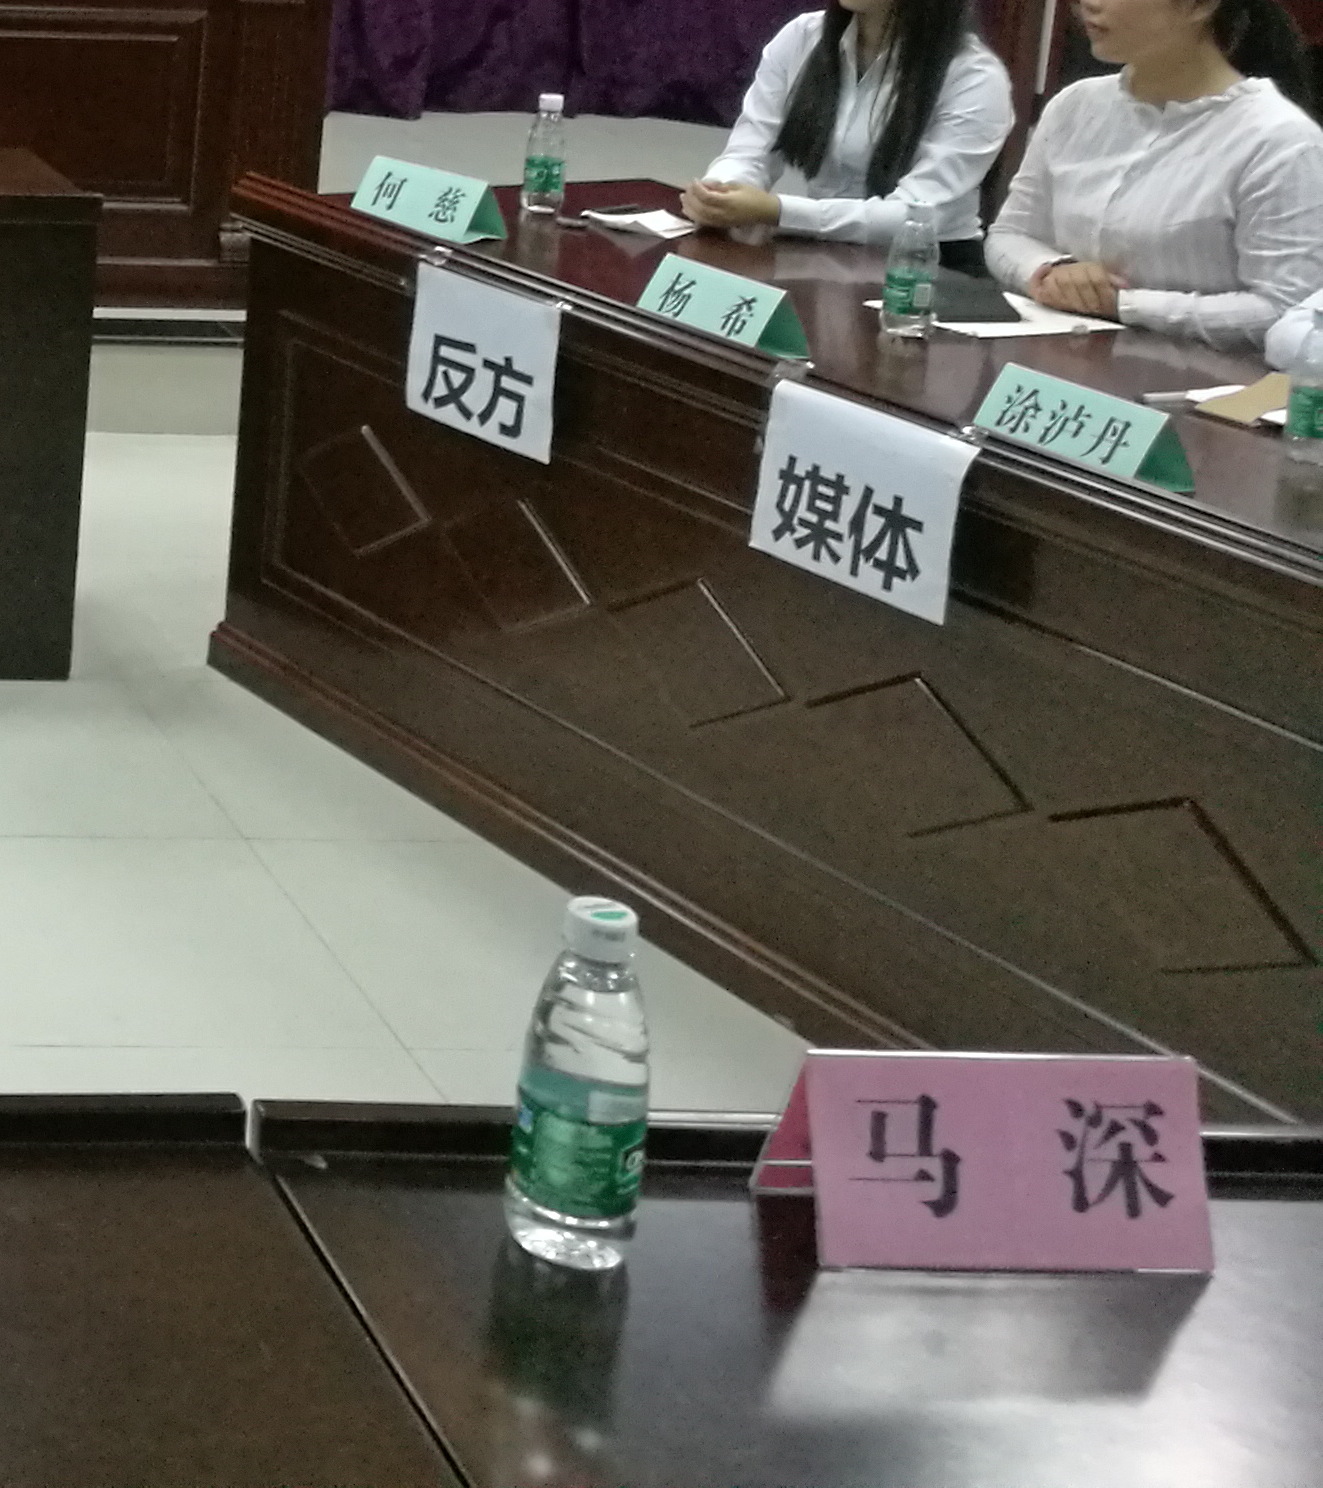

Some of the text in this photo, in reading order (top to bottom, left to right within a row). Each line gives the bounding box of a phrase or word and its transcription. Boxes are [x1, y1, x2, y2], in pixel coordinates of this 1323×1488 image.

[658, 273, 757, 338] 杨希
[421, 333, 534, 438] 反方
[772, 455, 924, 593] 媒体
[848, 1093, 1174, 1219] 马深
